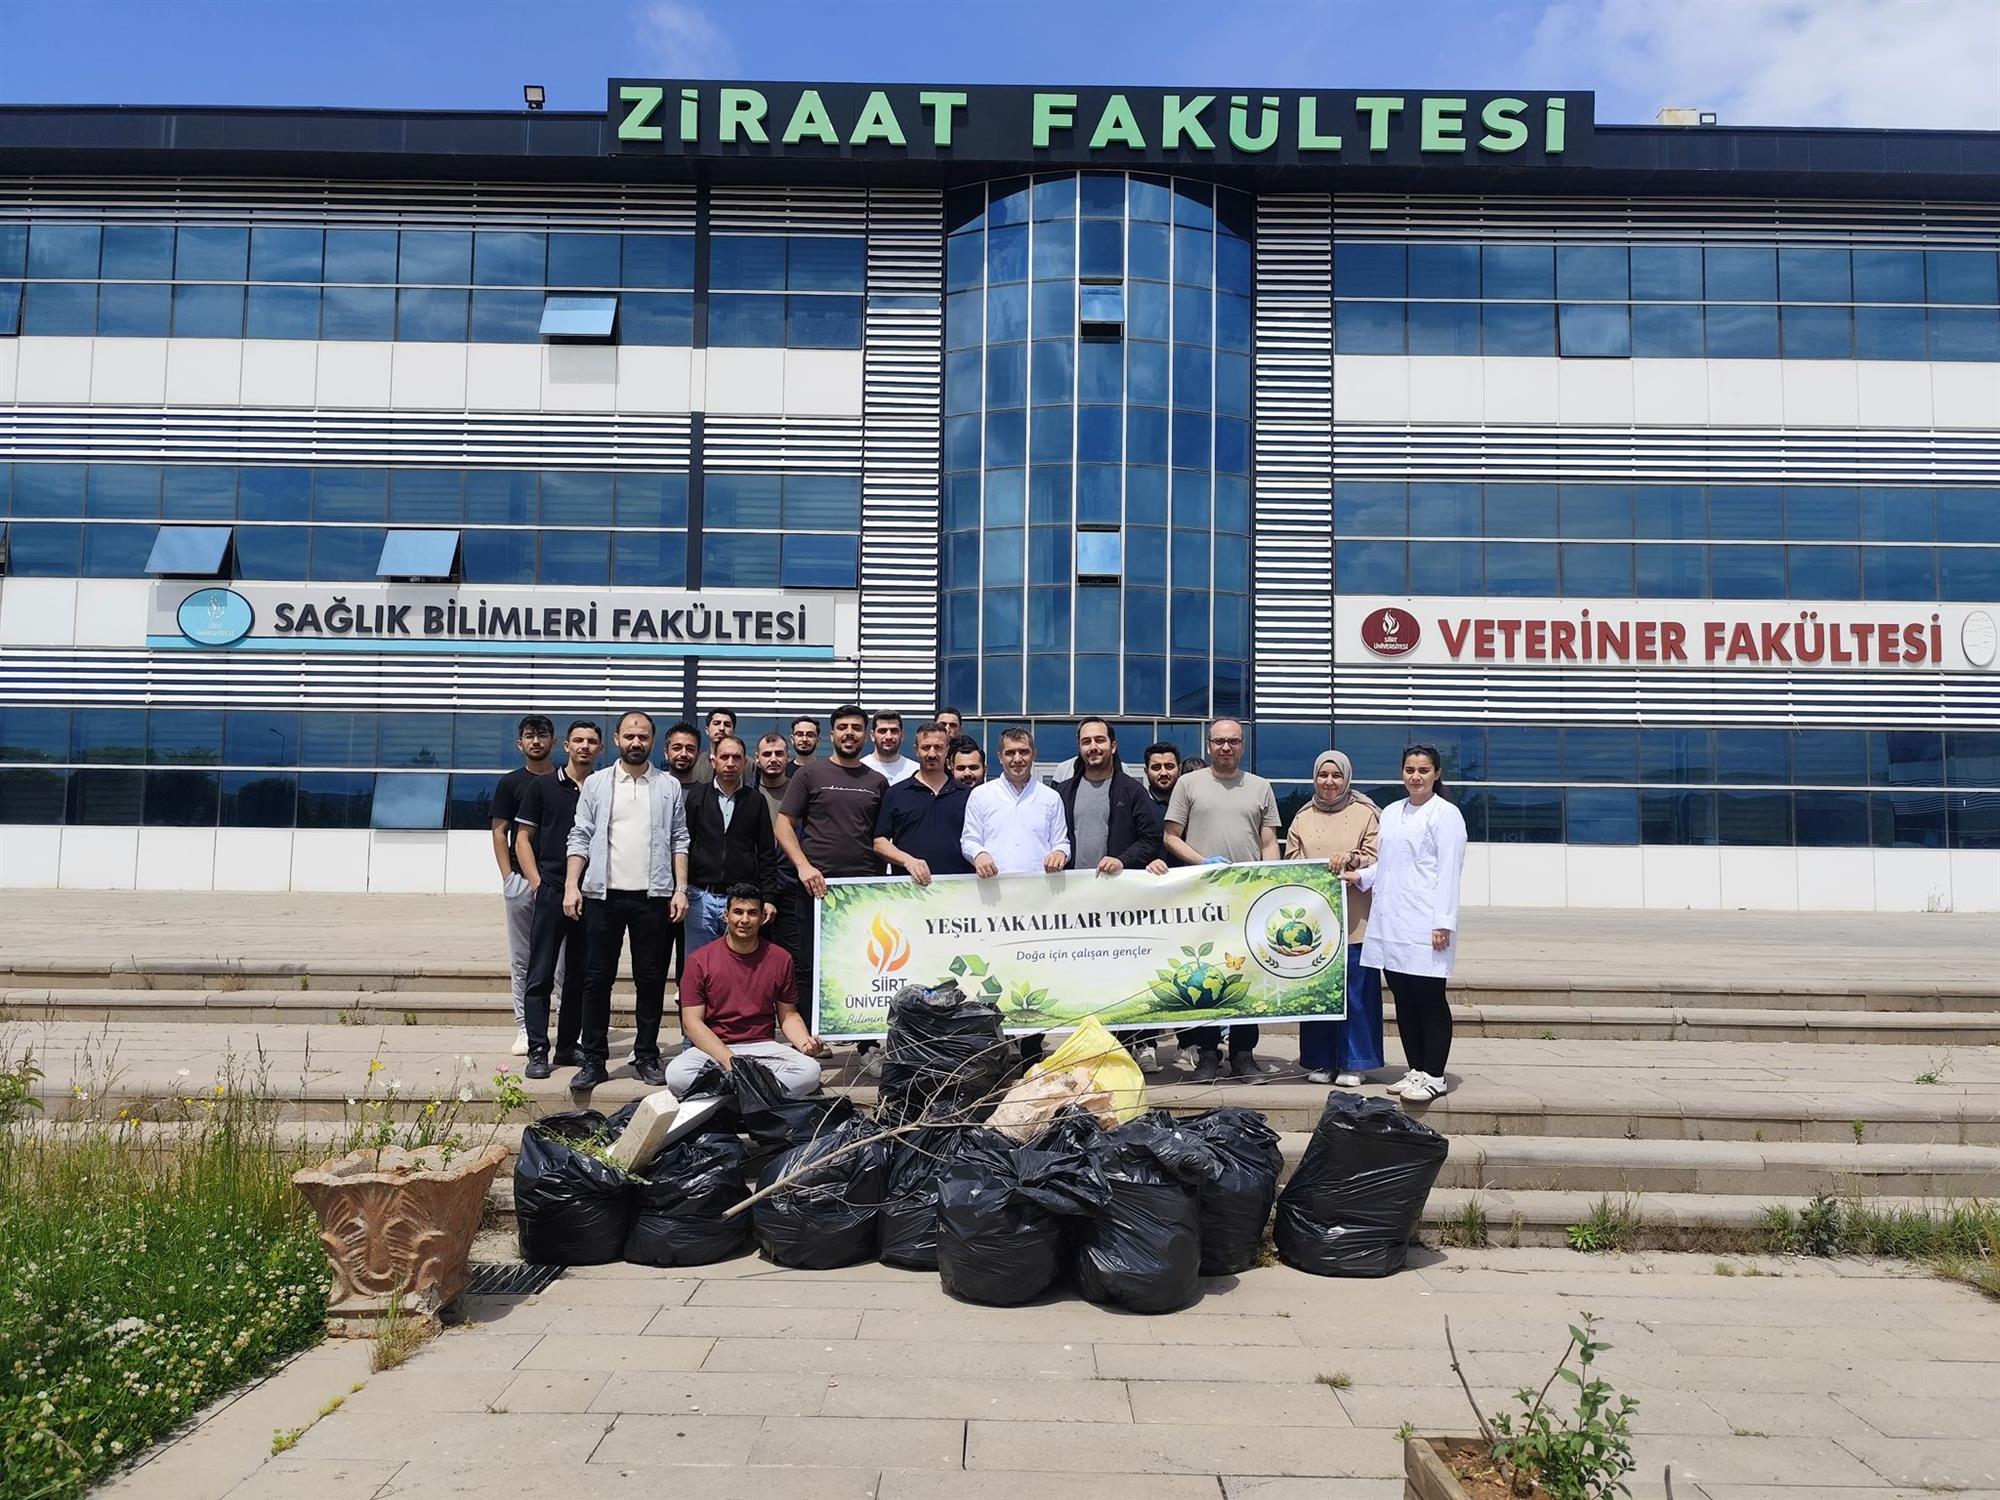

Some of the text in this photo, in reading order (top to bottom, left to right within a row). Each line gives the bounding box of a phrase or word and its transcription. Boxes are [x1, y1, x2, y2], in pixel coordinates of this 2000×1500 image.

[273, 596, 807, 640] SAĞLIK BİLİMLERİ FAKÜLTESİ
[1438, 609, 1943, 664] VETERİNER FAKÜLTESİ
[986, 911, 1102, 933] YAKALILAR
[1106, 902, 1232, 929] TOPLULUĞU
[1016, 946, 1153, 962] Doğa için çalışan gençler
[845, 994, 893, 1008] ÜNİVER
